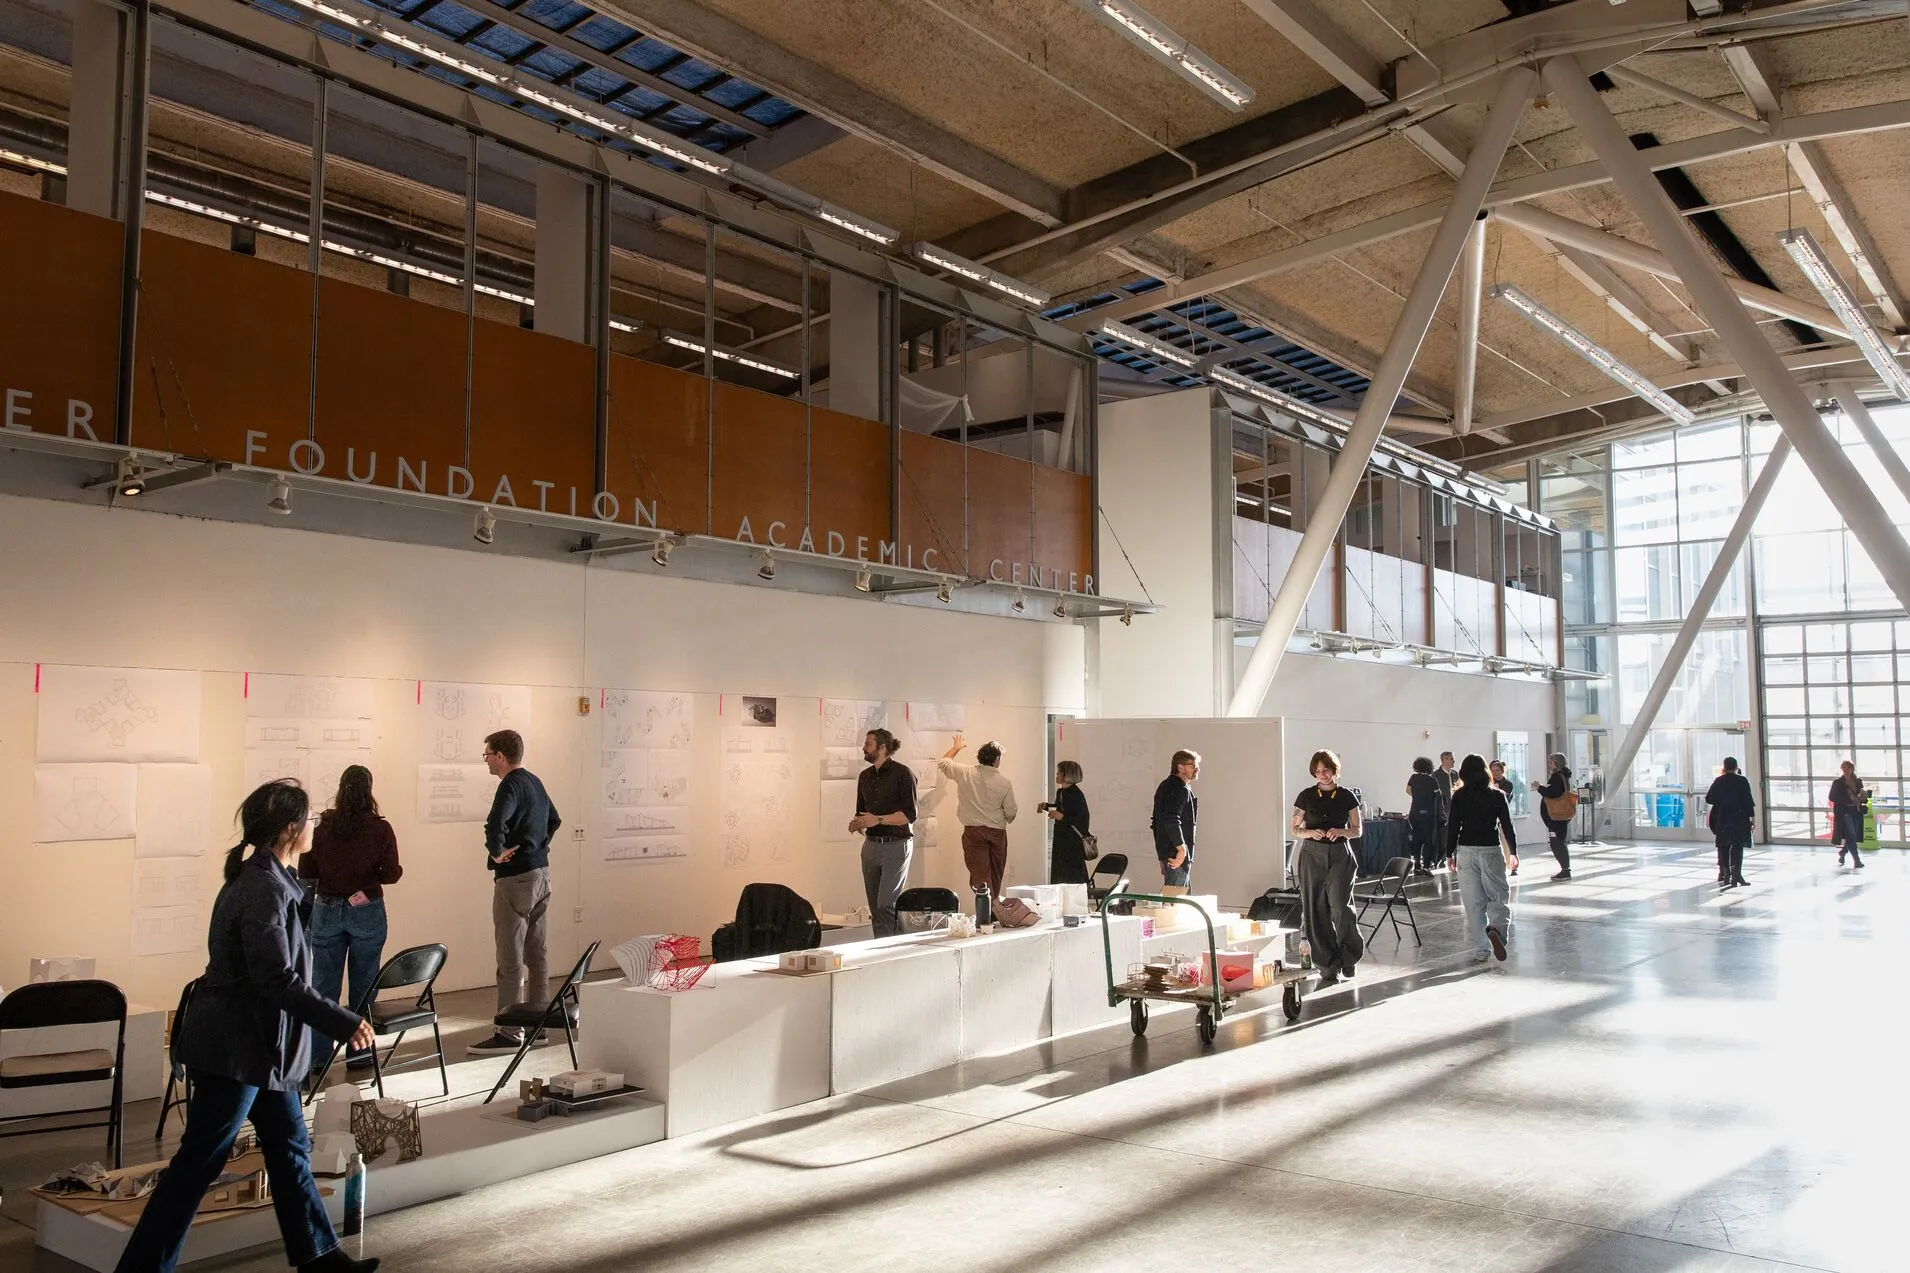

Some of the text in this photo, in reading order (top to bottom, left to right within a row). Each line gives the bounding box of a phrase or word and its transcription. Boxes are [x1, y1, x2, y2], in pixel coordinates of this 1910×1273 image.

[5, 388, 1095, 595] ER FOUNDATION ACADEMIC CENTER
